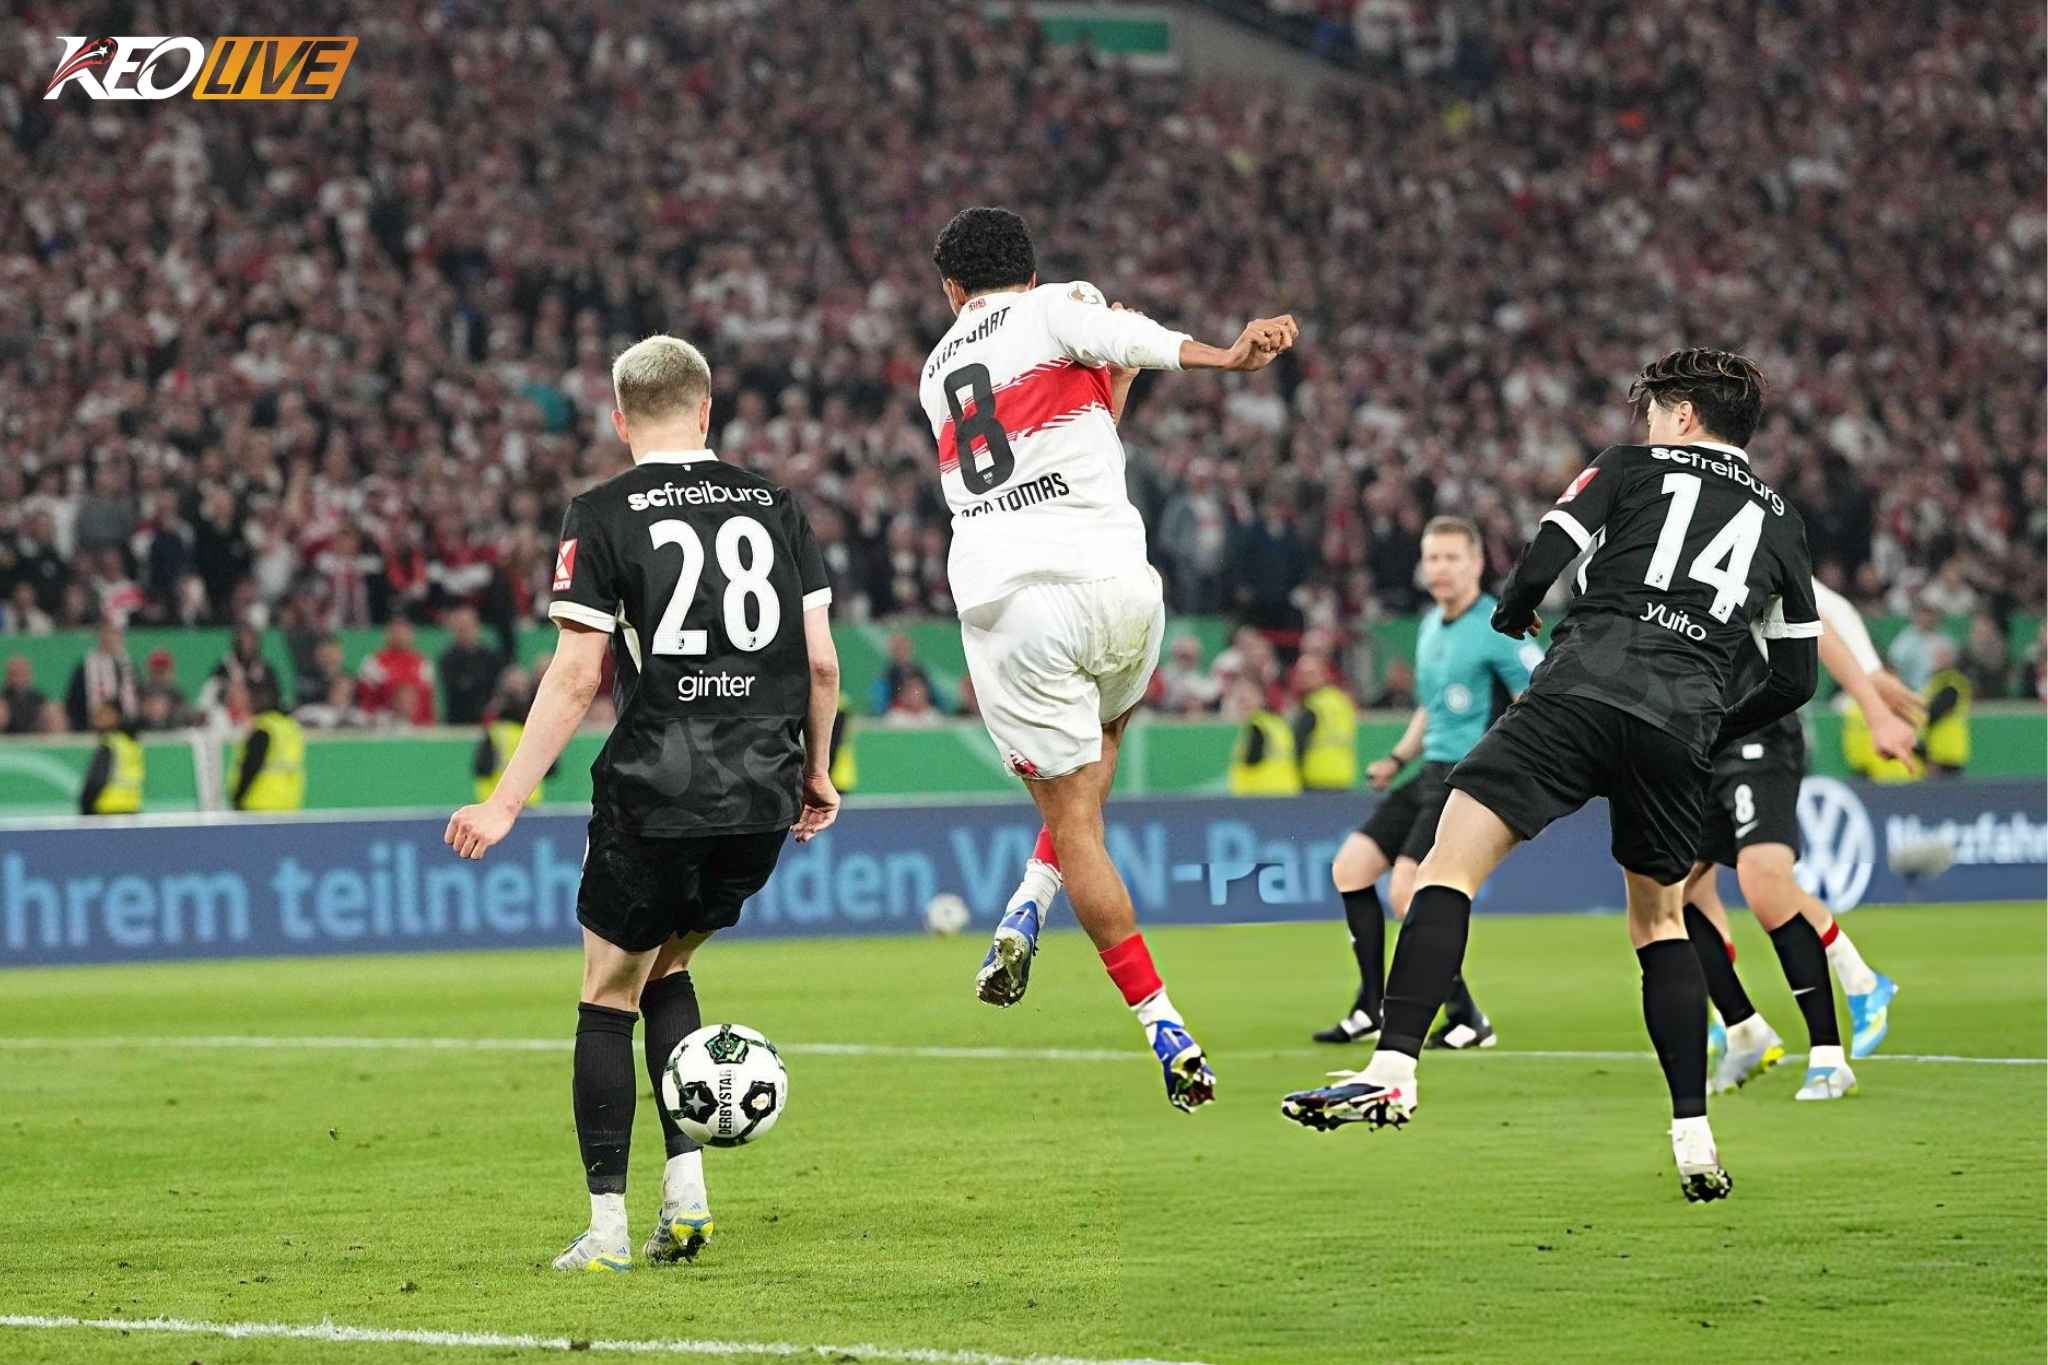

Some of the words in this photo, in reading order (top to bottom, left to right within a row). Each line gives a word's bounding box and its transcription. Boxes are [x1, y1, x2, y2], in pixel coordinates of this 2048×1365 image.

[943, 362, 1015, 495] 8
[995, 471, 1070, 512] TOMAS
[1643, 472, 1767, 625] 14
[648, 515, 781, 656] 28
[1639, 601, 1707, 641] yuito
[677, 669, 756, 702] ginter
[1734, 783, 1755, 824] 8
